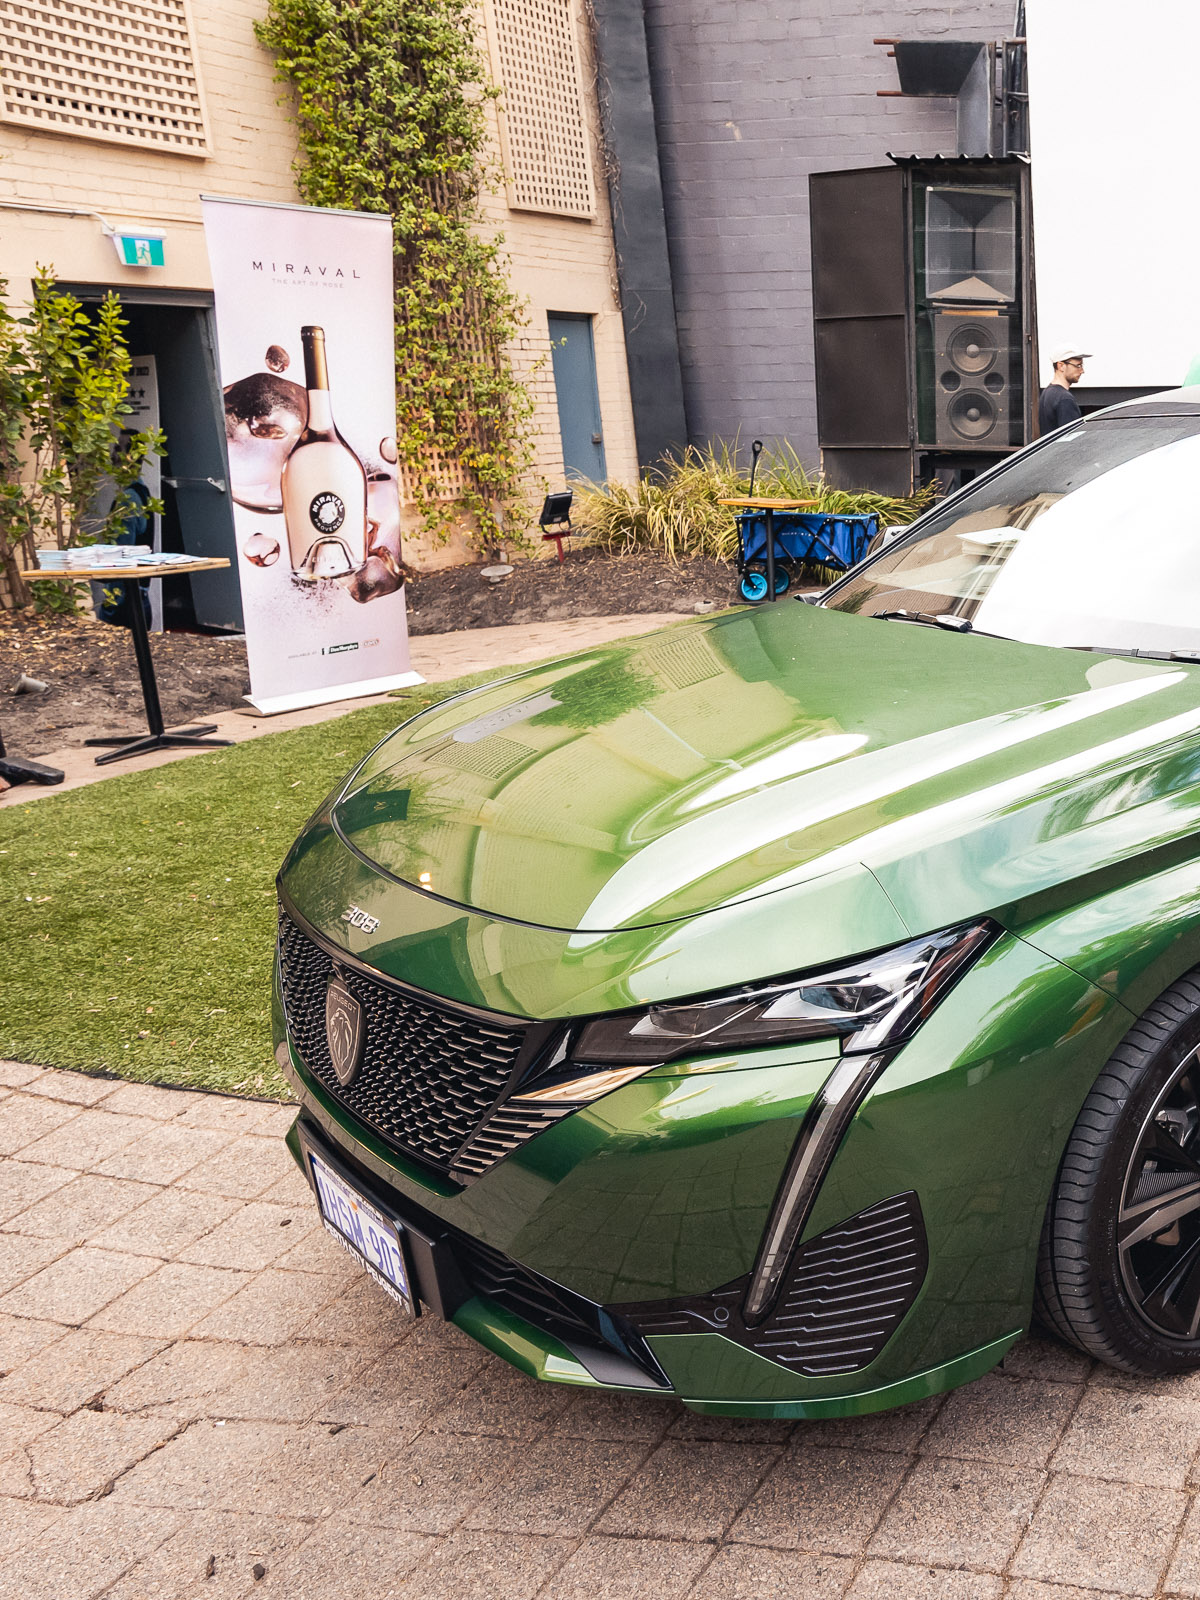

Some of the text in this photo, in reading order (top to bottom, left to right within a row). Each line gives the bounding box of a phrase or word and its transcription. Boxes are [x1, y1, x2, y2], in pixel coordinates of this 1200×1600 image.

[252, 260, 360, 279] MIRAVAL
[312, 495, 344, 512] MIRAVAL
[313, 518, 343, 532] PROVENCE
[340, 903, 380, 934] 308
[330, 990, 357, 1013] PEUGEOT
[324, 1218, 349, 1252] PERTH
[348, 1244, 365, 1268] CITY
[365, 1260, 402, 1307] PEUGEOT
